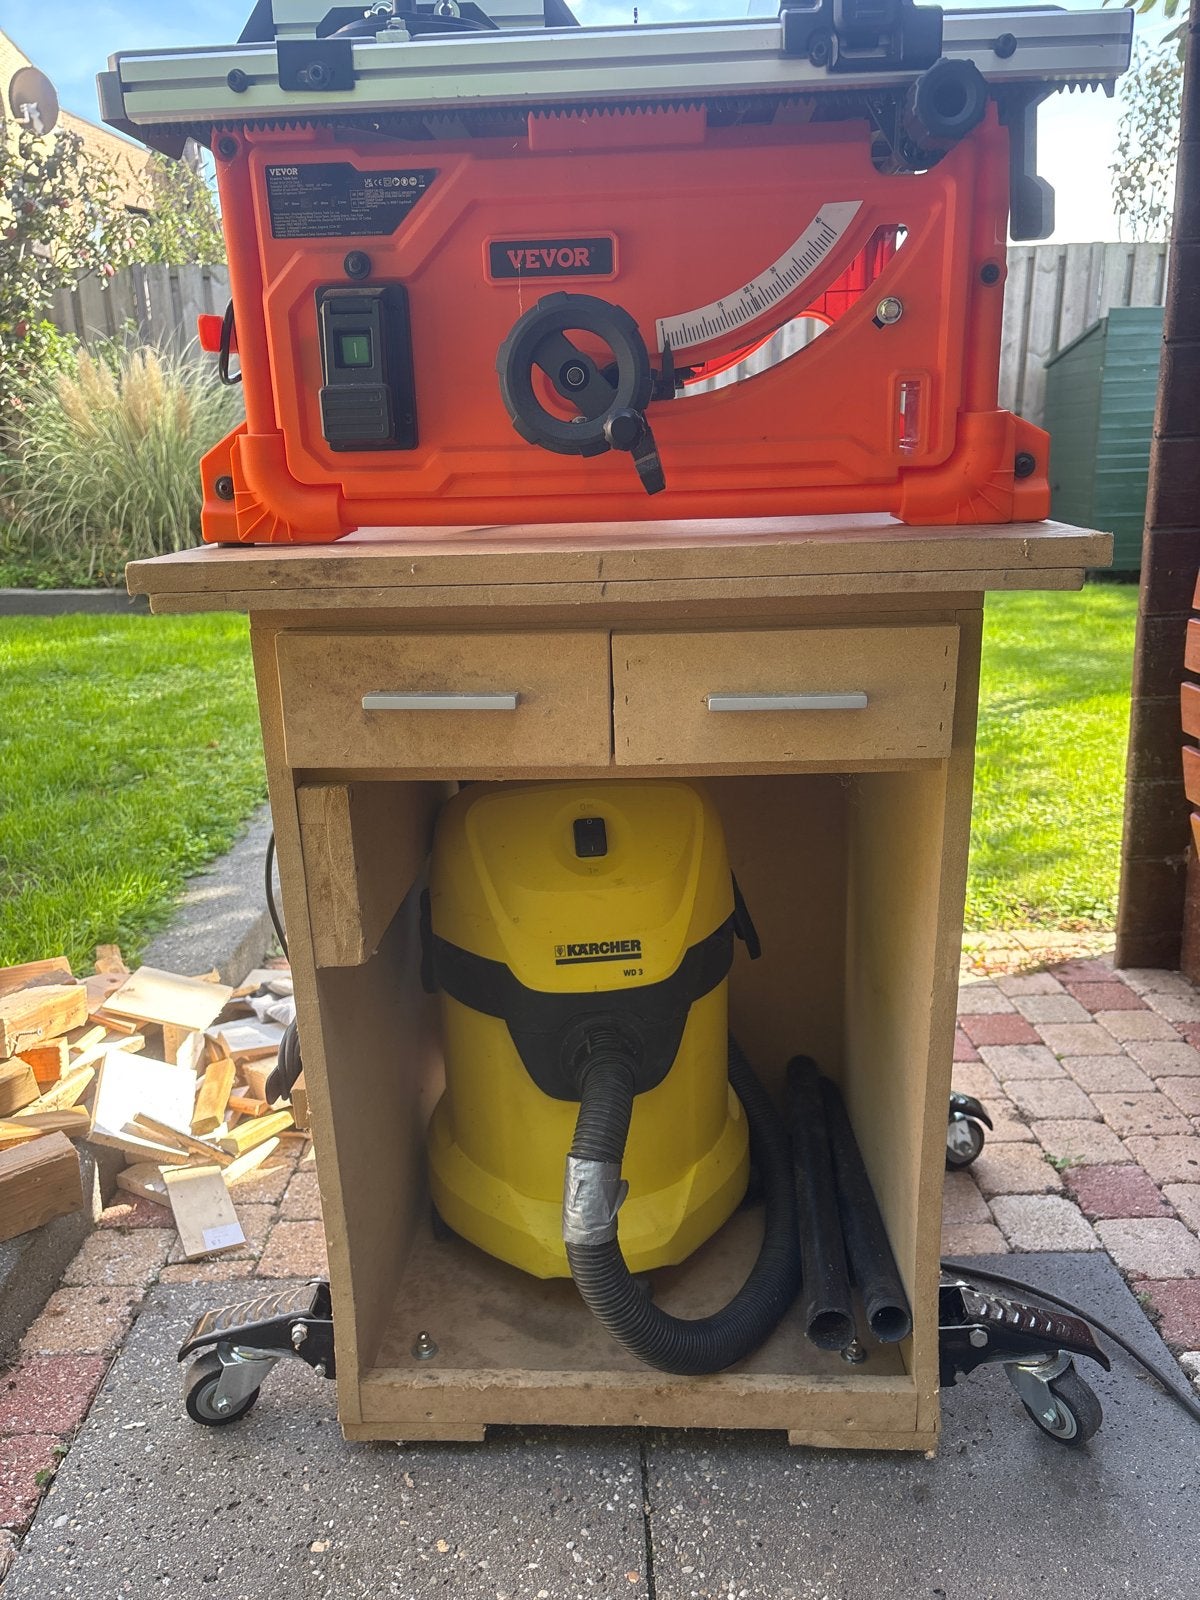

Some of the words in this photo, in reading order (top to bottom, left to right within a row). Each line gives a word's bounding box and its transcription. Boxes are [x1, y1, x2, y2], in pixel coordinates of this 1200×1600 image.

[269, 168, 298, 176] VEVOR
[507, 247, 590, 269] VEVOR
[566, 939, 642, 957] KÄRCHER
[623, 969, 636, 977] WD
[638, 968, 644, 976] 3
